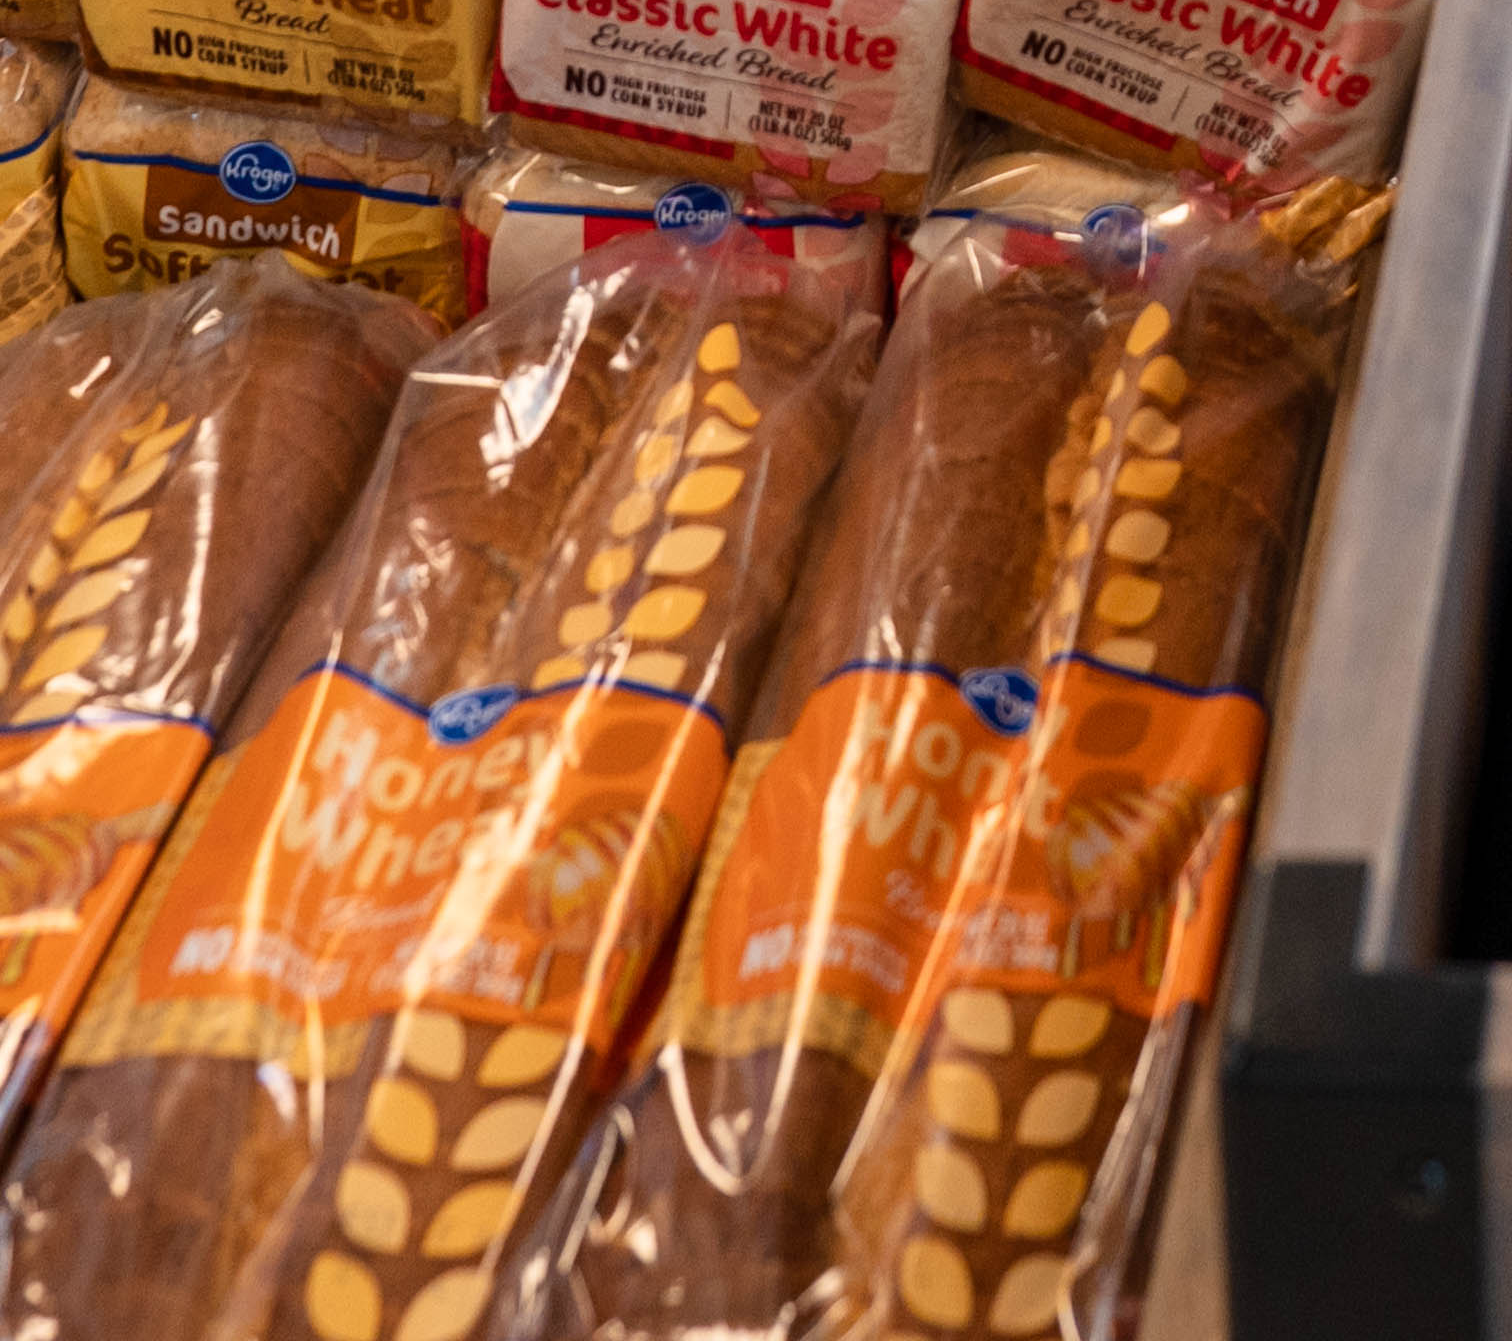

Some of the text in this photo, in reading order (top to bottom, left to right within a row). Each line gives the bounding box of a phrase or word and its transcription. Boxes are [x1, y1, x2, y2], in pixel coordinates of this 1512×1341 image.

[152, 27, 193, 59] NO
[590, 23, 838, 92] Enriched Bread
[733, 0, 898, 72] White
[1065, 1, 1297, 108] Enriched Bread
[1219, 5, 1373, 109] White
[565, 65, 606, 99] NO
